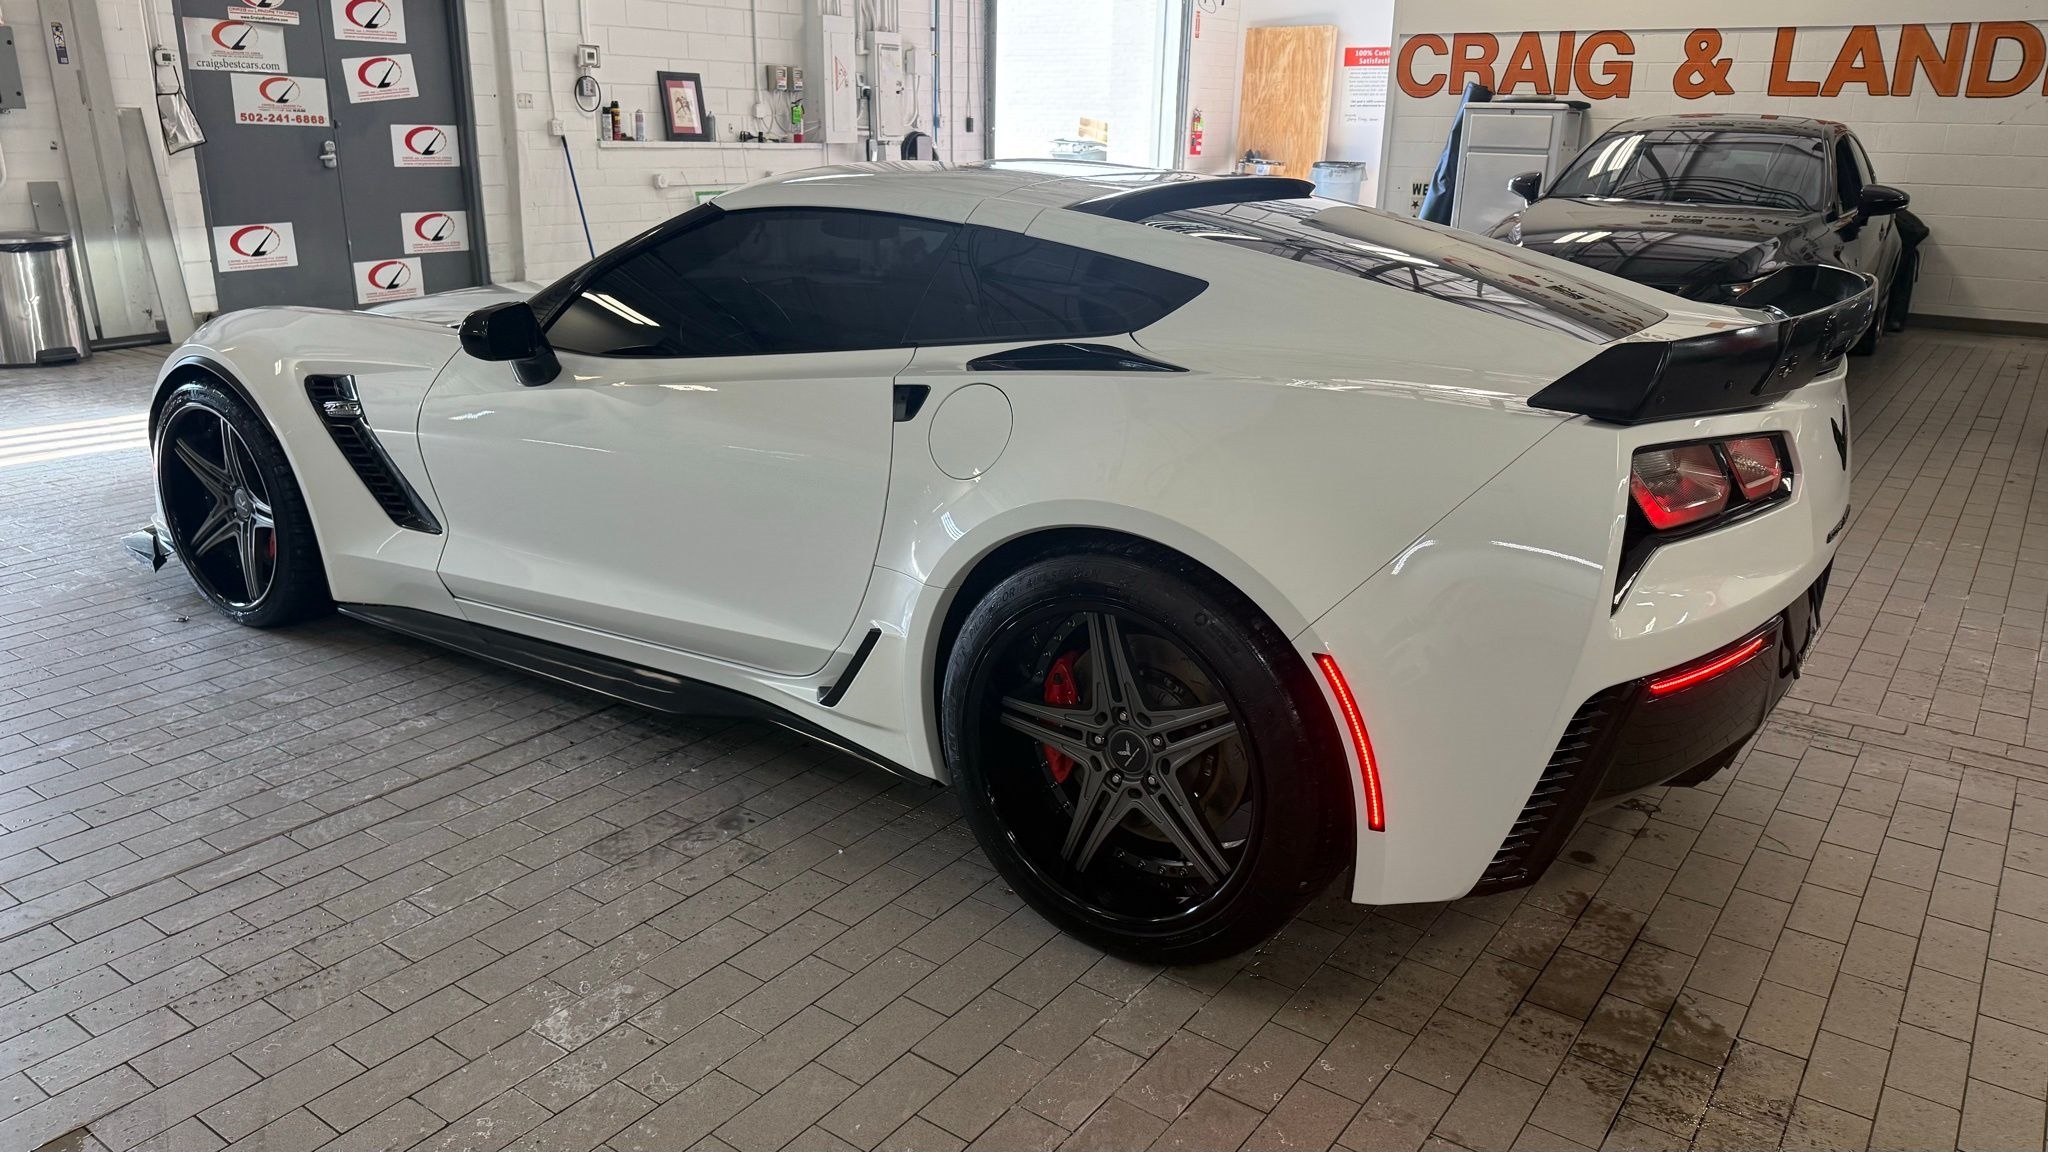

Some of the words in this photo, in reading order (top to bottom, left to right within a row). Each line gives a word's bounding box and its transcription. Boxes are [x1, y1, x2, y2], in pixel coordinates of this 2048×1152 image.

[1355, 49, 1372, 57] 100%
[196, 58, 280, 71] craigsbestcars.com
[1397, 29, 1635, 99] CRAIG
[1673, 28, 1735, 99] &
[1767, 20, 2048, 98] LAND
[240, 112, 325, 124] 502-241-6868
